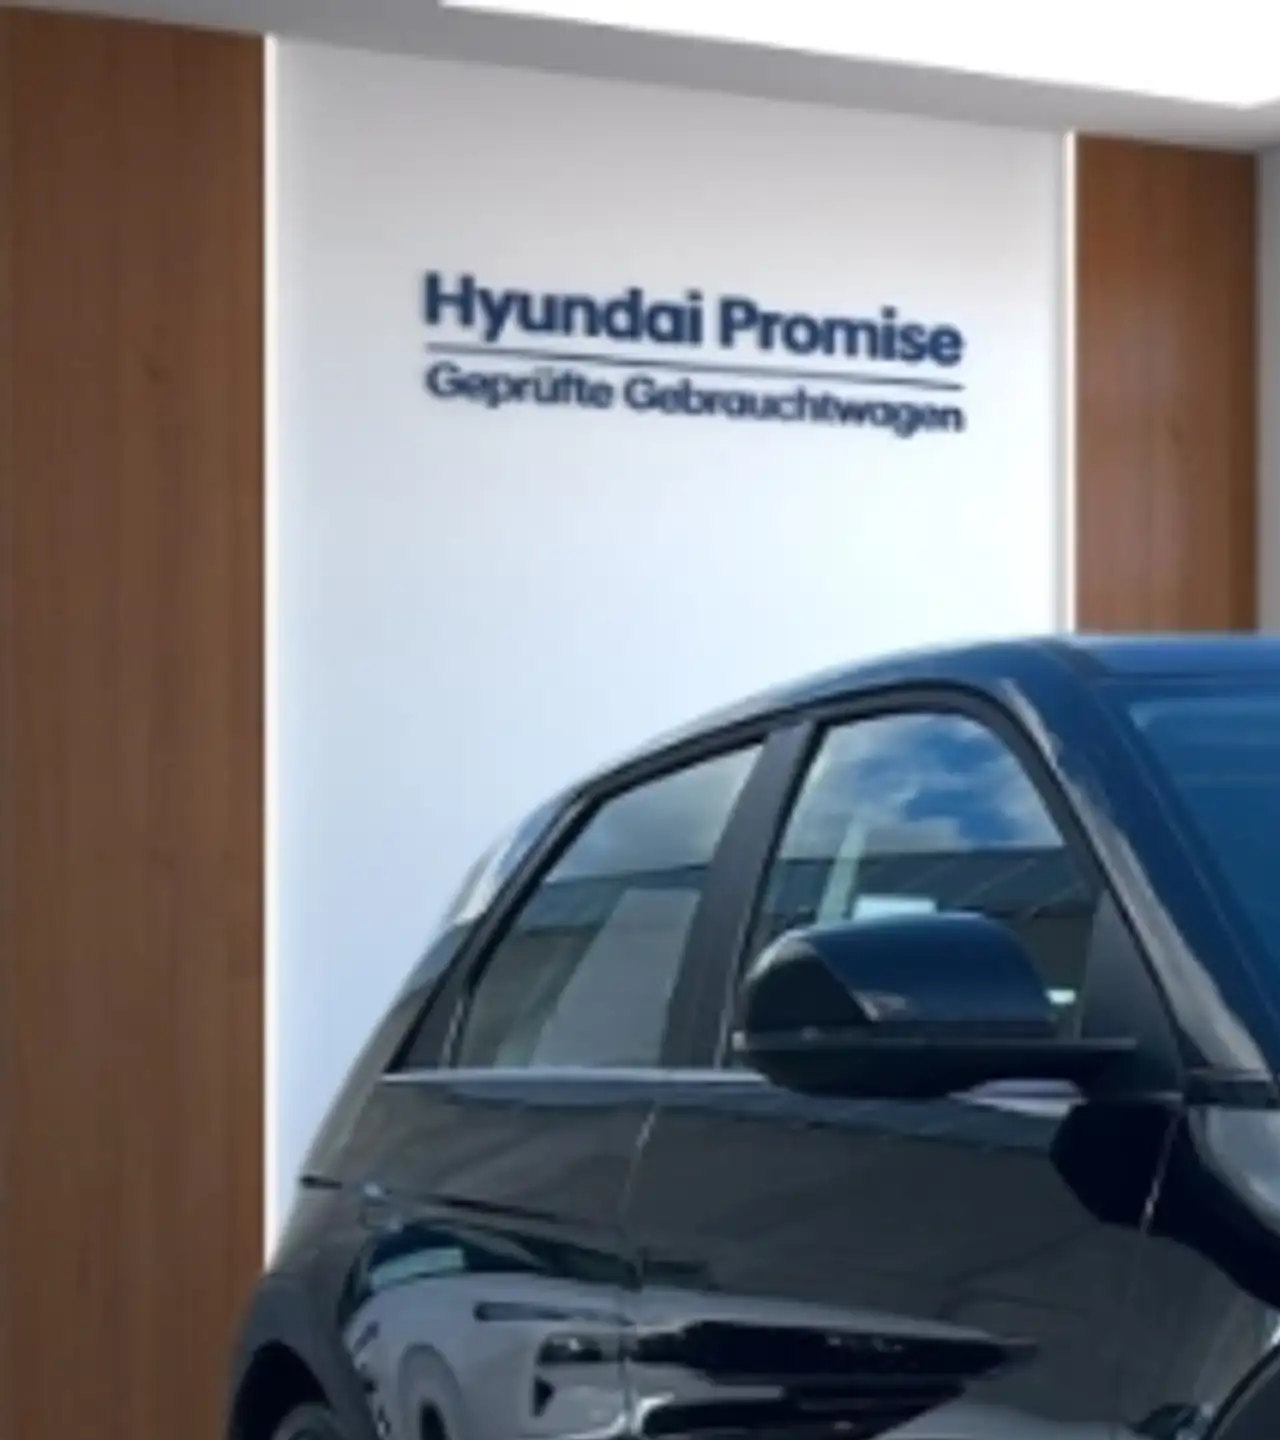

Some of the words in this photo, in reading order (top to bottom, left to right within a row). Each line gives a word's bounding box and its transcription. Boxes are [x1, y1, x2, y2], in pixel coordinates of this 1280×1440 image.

[424, 272, 701, 344] Hyundai
[719, 298, 963, 364] Promise
[425, 363, 614, 408] Geprüfte
[624, 378, 964, 436] Gebrauchtwagen
